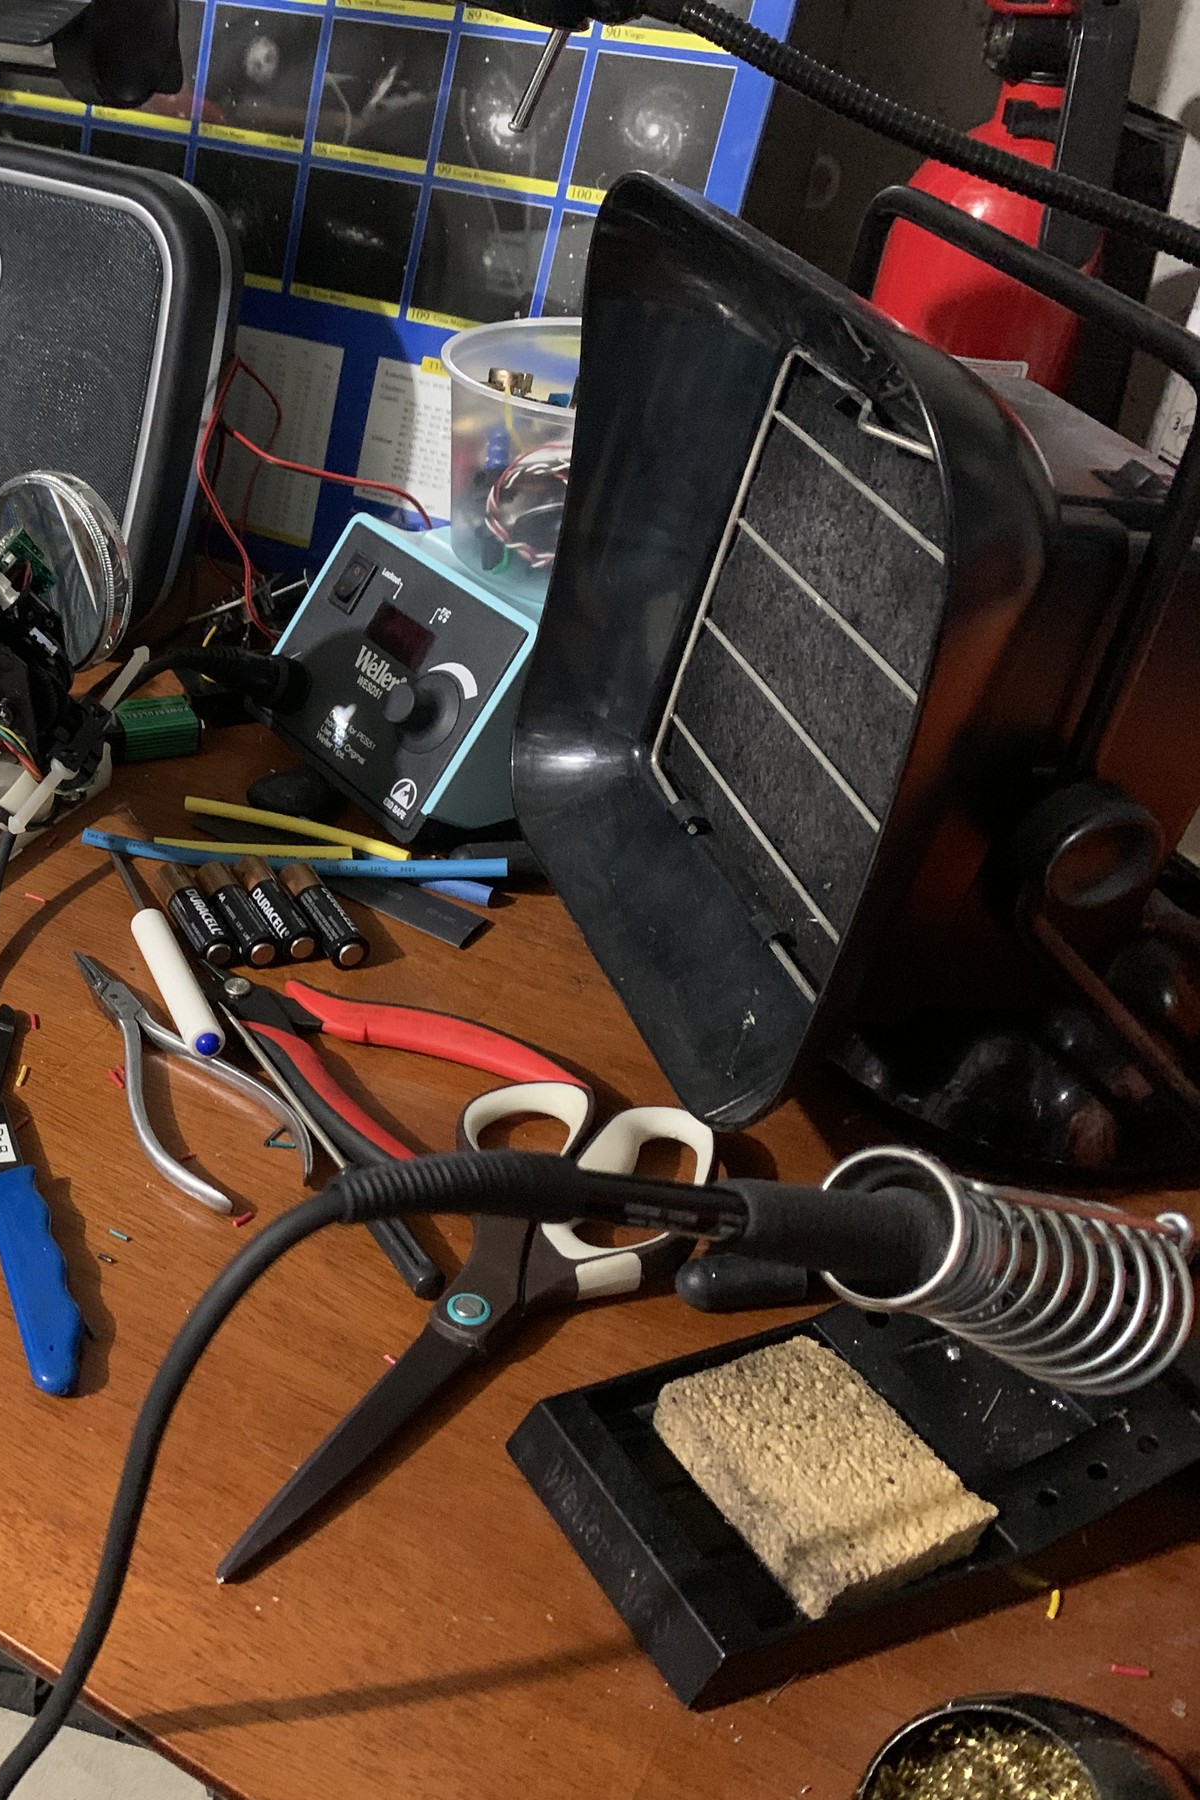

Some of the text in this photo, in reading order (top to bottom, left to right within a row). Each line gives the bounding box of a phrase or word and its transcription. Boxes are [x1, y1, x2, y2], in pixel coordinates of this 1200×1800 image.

[466, 9, 482, 22] 89
[605, 26, 621, 39] 90
[571, 188, 593, 201] 100
[411, 308, 431, 321] 109
[354, 644, 400, 691] Weller
[357, 674, 383, 699] WESD51
[184, 888, 220, 936] DURACELL
[252, 887, 289, 939] DURACELL
